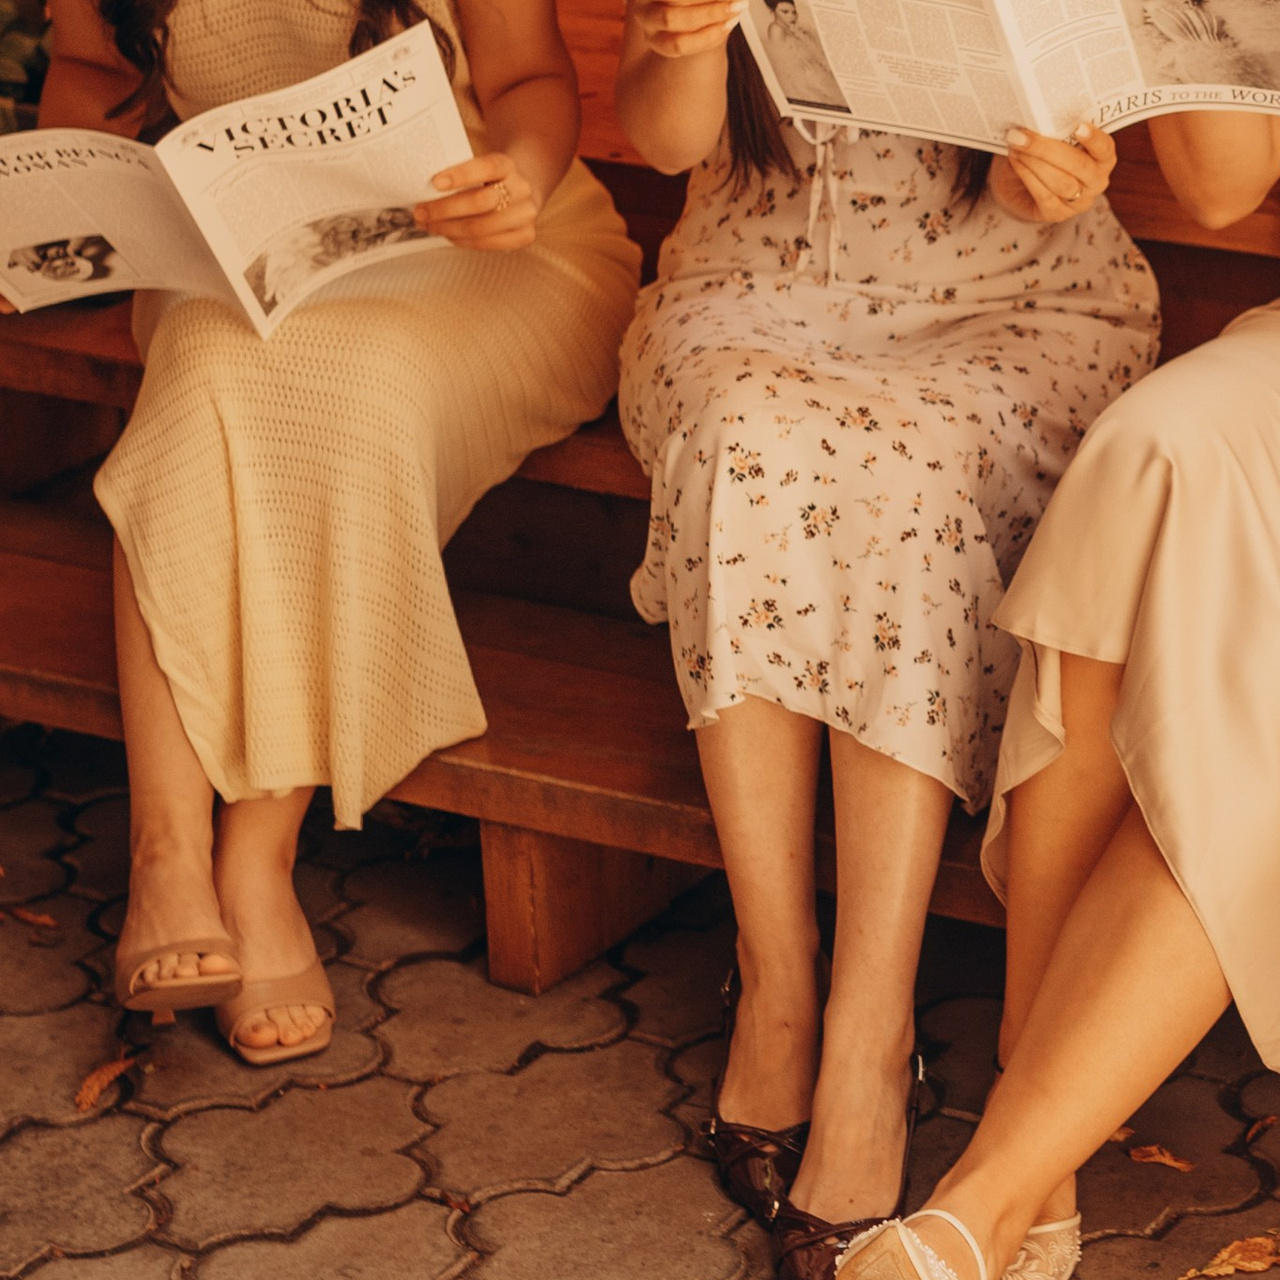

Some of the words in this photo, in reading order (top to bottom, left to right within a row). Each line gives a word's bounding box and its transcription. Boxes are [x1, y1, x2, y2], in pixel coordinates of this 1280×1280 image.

[196, 70, 417, 153] VICTORIA's
[1100, 89, 1162, 124] PARIS
[1169, 91, 1191, 101] TO
[1193, 91, 1223, 100] THE
[233, 101, 394, 159] SECRET
[16, 150, 46, 162] OF
[55, 148, 131, 163] BEING
[137, 158, 151, 170] A
